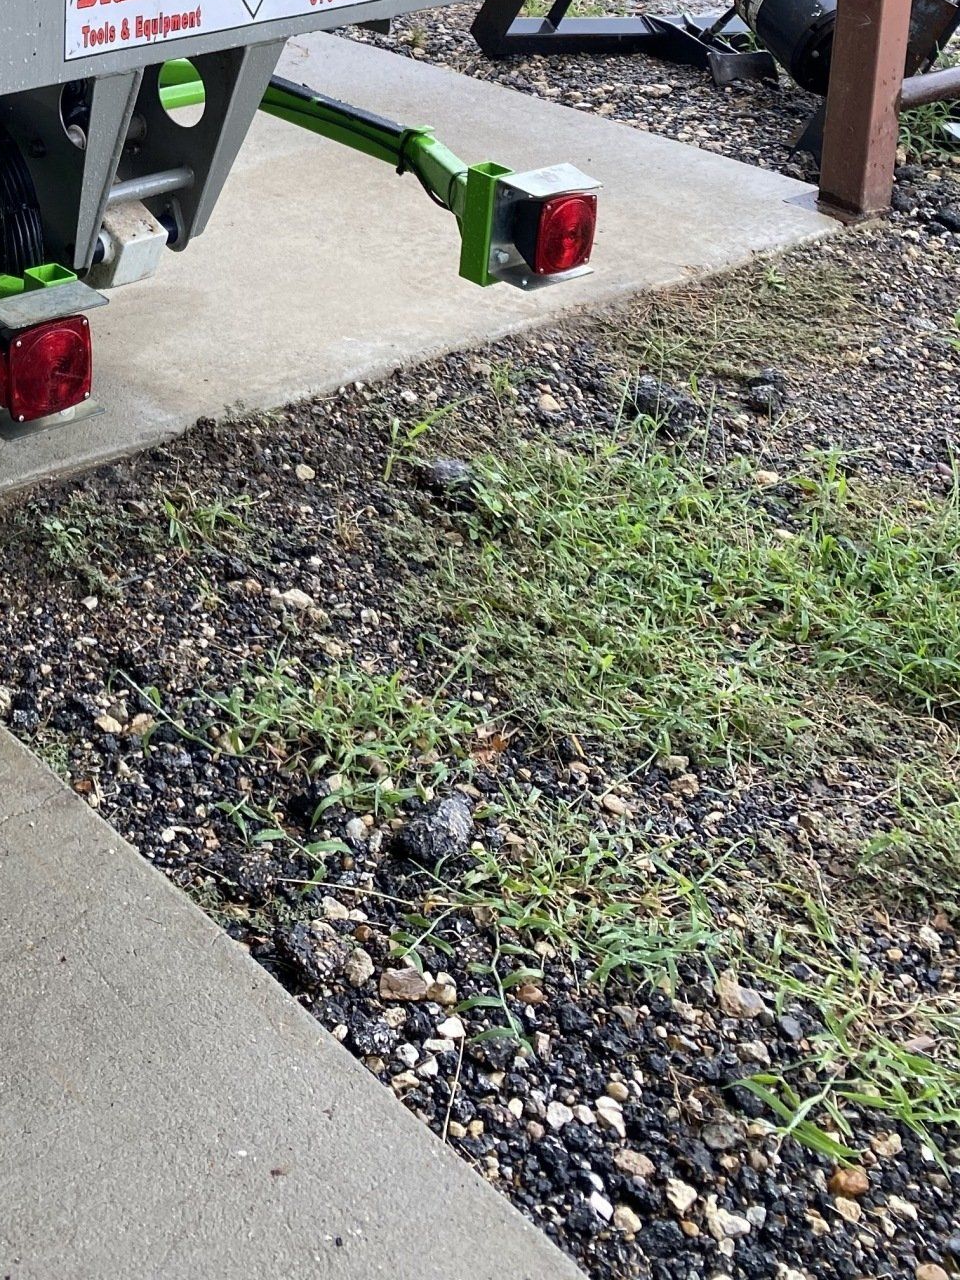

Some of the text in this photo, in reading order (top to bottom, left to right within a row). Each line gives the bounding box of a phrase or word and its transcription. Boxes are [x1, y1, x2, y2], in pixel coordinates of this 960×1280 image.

[82, 5, 201, 48] Tools & Equipment
